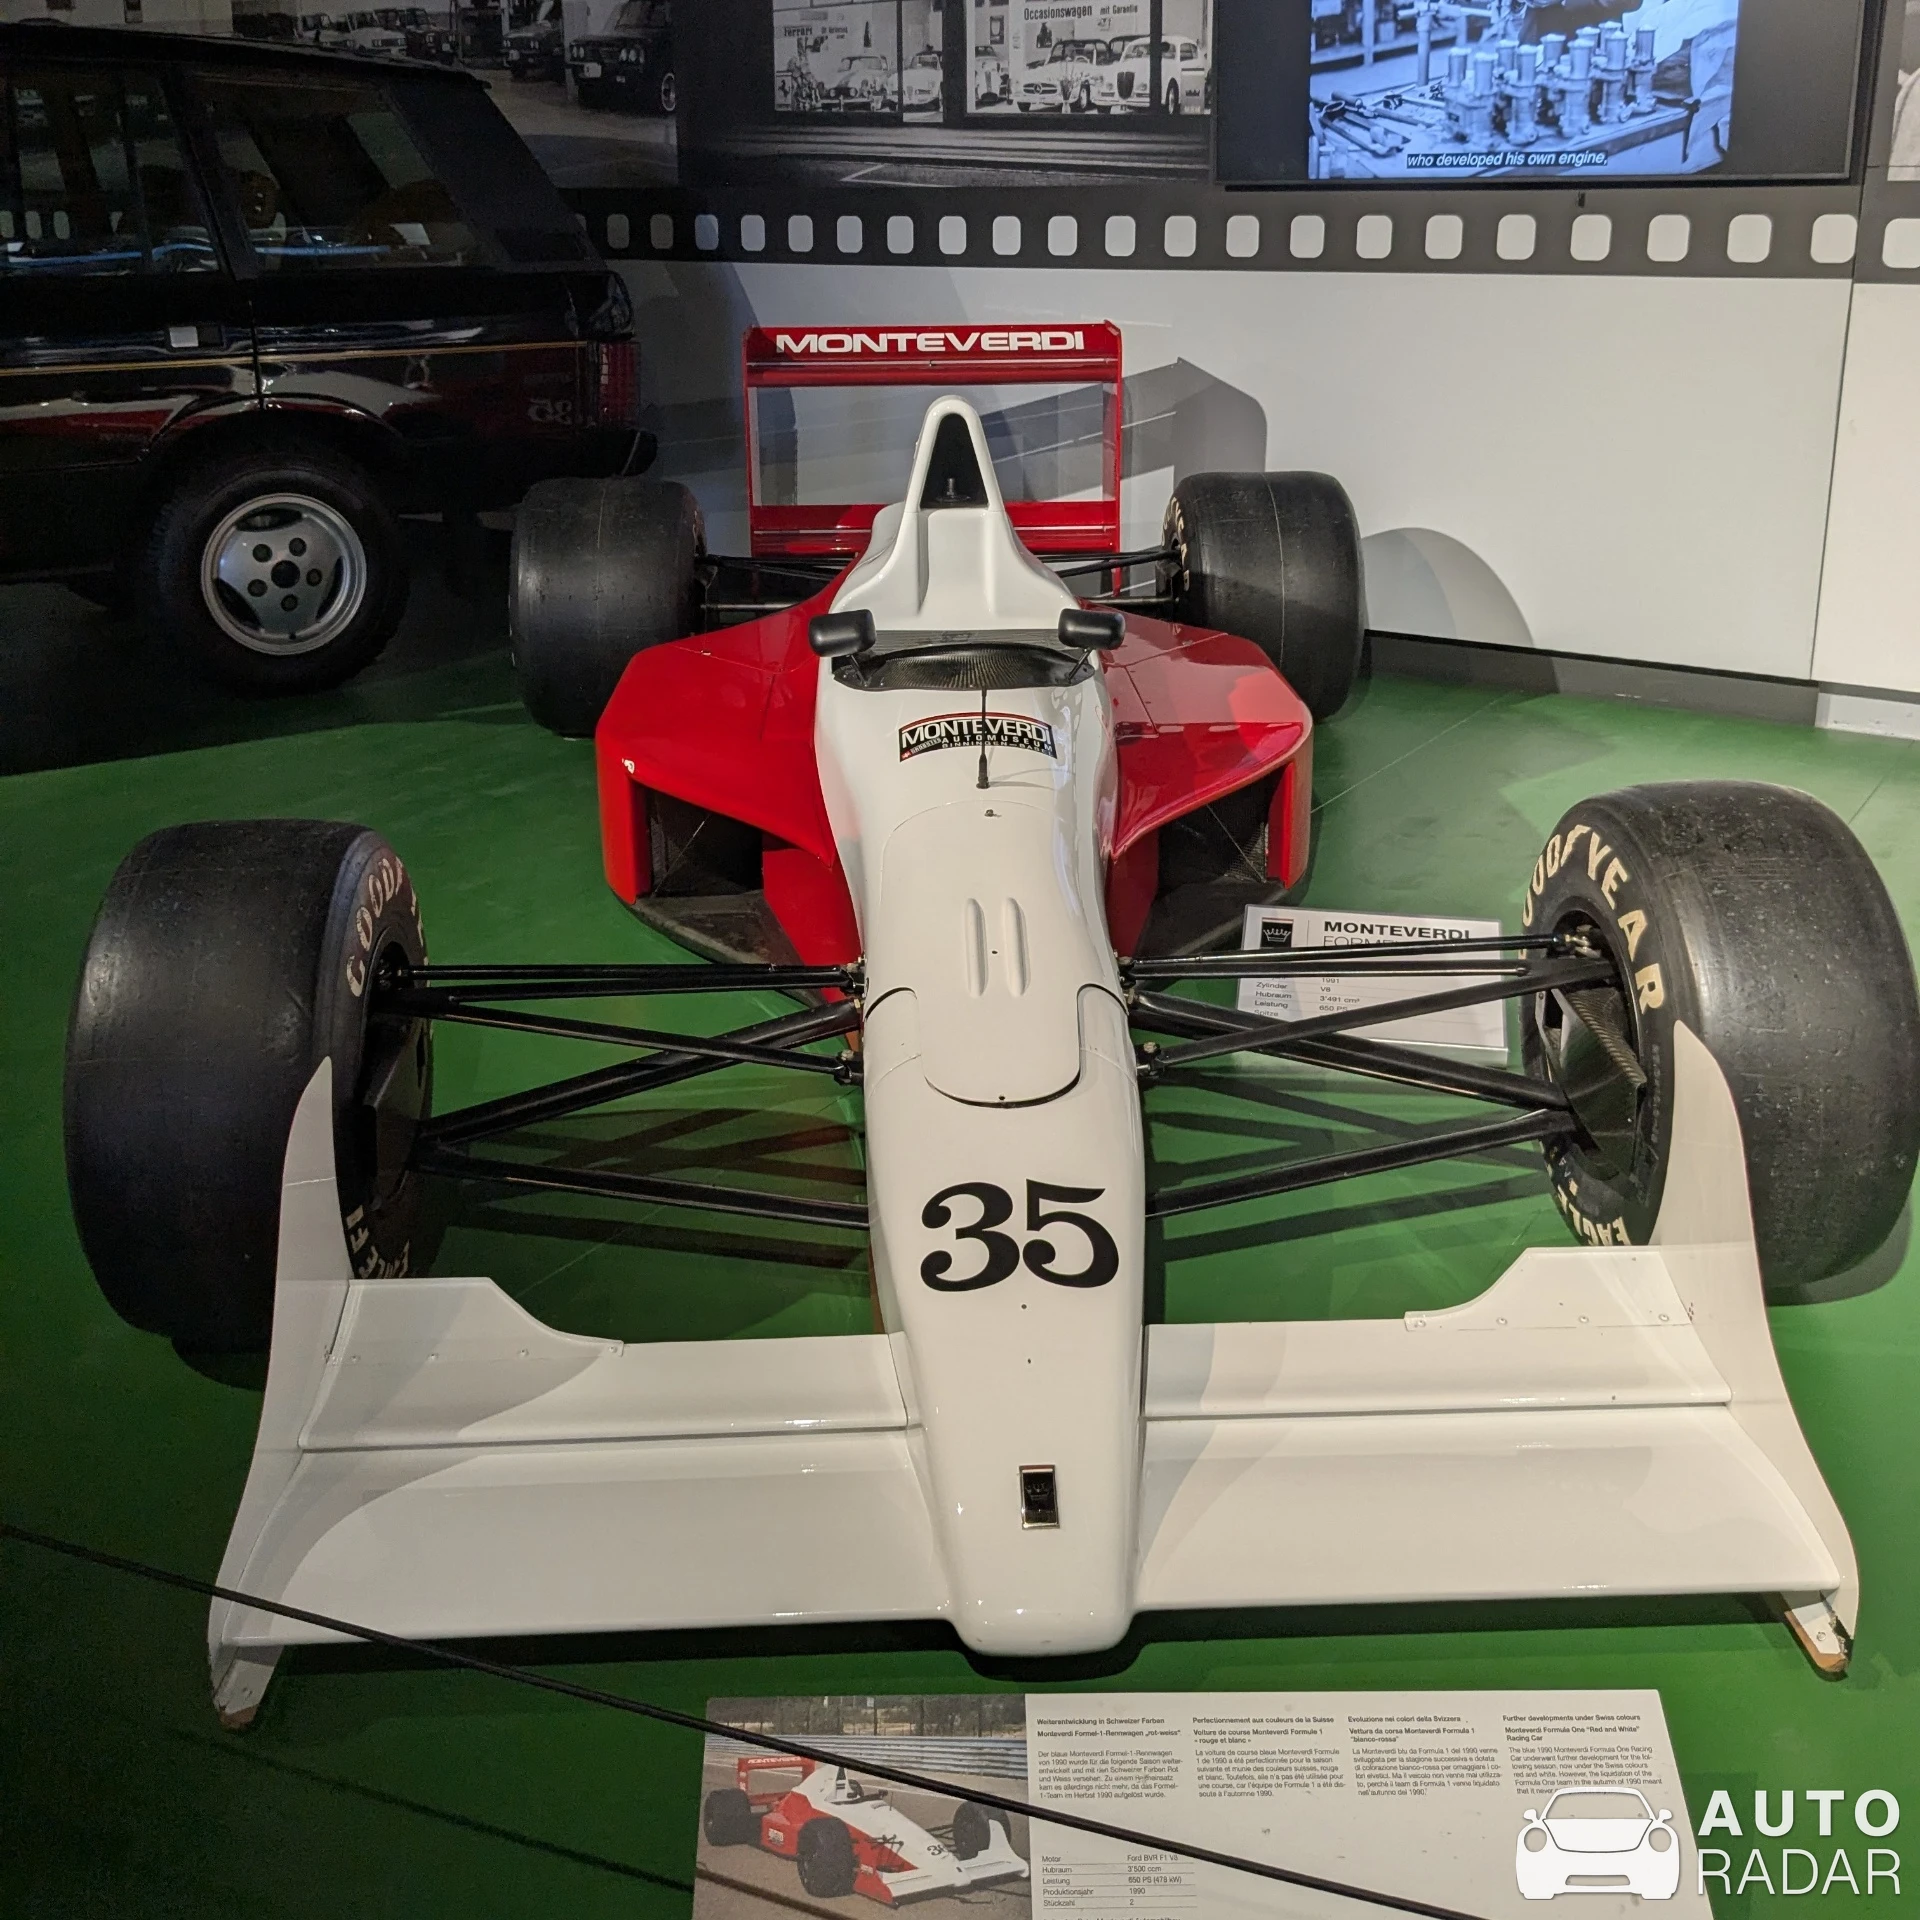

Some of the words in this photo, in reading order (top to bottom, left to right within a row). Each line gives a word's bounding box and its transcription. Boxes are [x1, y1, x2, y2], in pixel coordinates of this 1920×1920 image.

[1024, 5, 1092, 20] Occasionswagen
[1112, 5, 1138, 15] Garantie
[1408, 154, 1434, 167] who
[1436, 152, 1501, 168] developed
[1505, 152, 1524, 165] his
[1527, 154, 1555, 165] own
[1558, 151, 1608, 167] engine,
[776, 331, 1084, 354] MONTEVERDI
[901, 719, 1052, 749] MONTEVERDI
[941, 734, 1054, 752] AUTOMUSEUM
[1324, 921, 1470, 940] MONTEVERDI
[1255, 1000, 1288, 1008] Leistung
[920, 1178, 1120, 1292] 35
[1506, 1735, 1530, 1743] Racing
